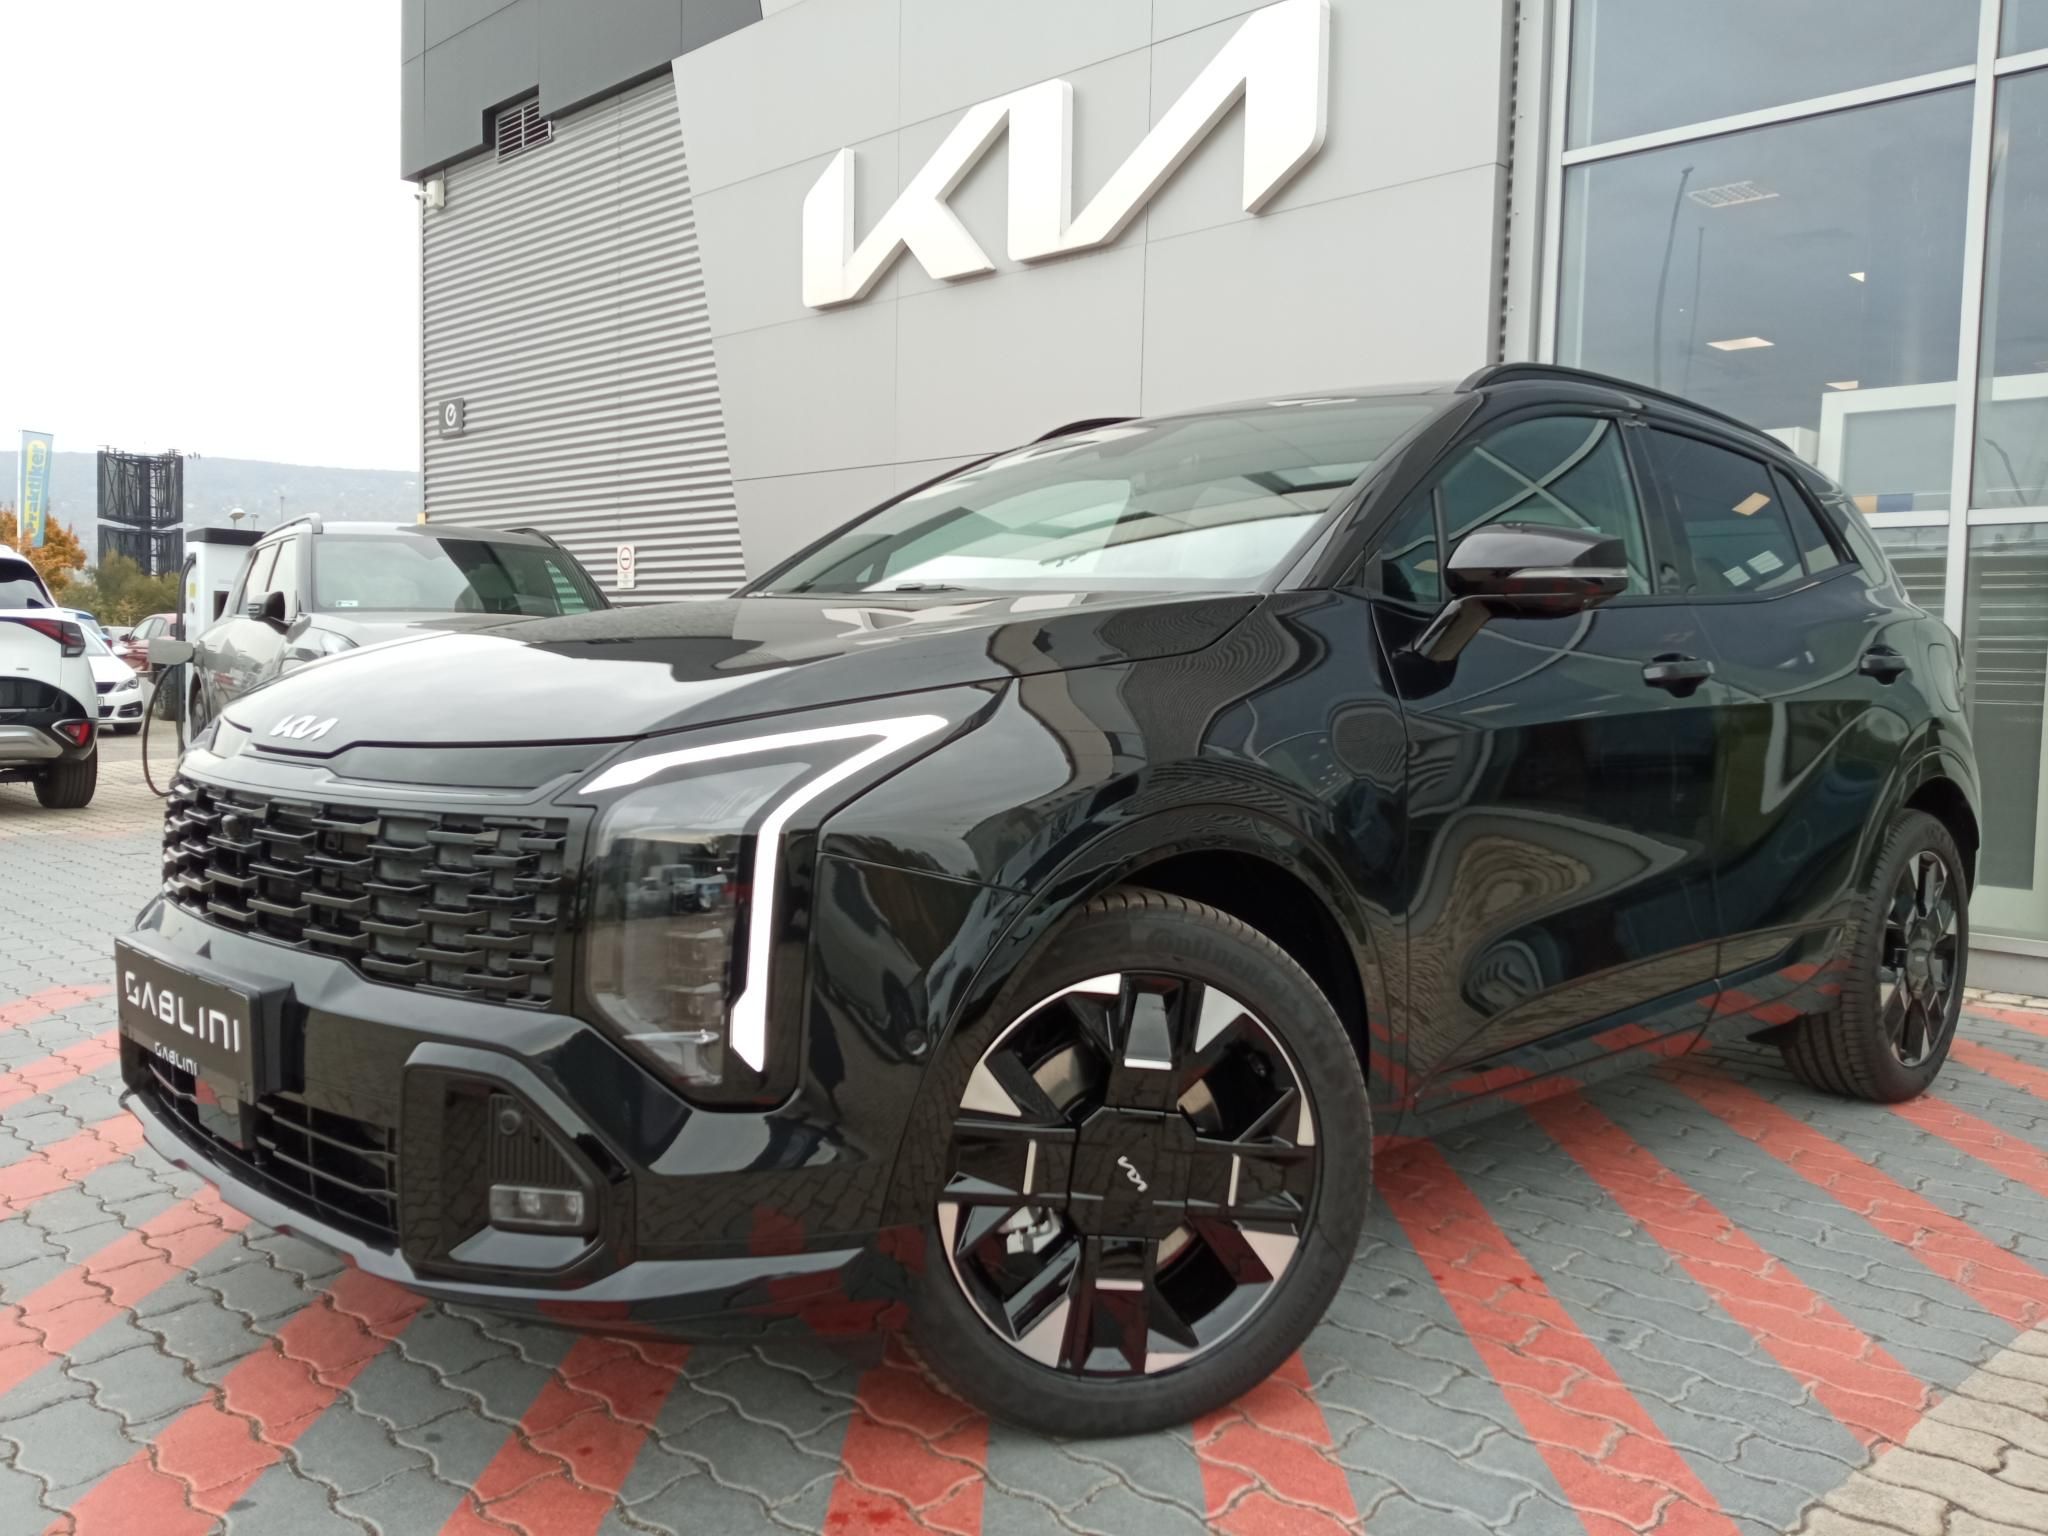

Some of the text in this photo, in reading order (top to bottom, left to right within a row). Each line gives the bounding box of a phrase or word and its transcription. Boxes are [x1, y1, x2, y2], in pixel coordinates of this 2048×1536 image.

[268, 713, 339, 742] KIA
[125, 970, 240, 1053] GABLINI
[154, 1041, 198, 1076] GABLINI
